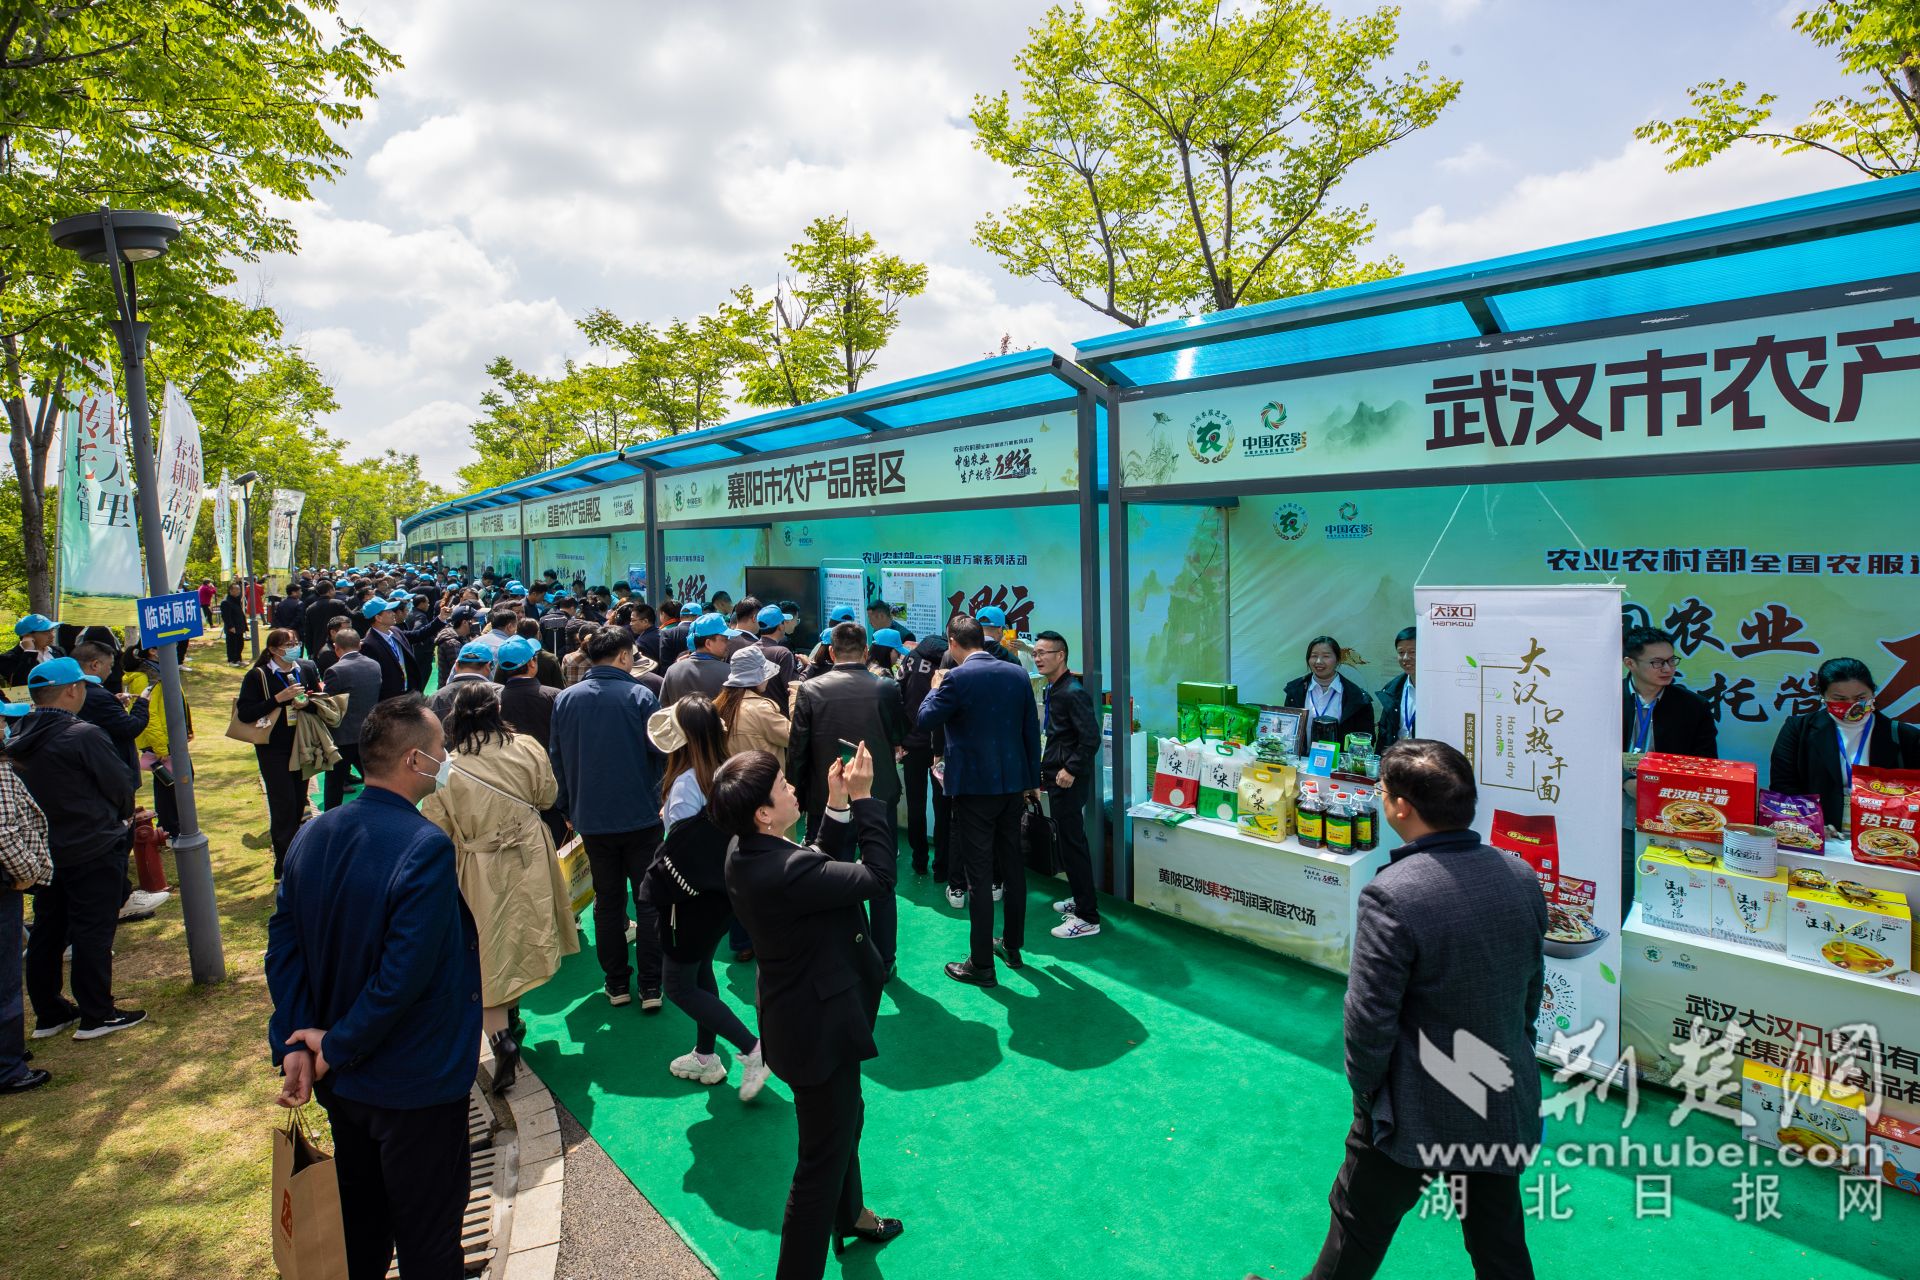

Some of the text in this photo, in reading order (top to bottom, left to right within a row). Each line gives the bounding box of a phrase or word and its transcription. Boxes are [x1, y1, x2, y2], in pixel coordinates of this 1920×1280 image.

[1243, 431, 1307, 451] 中国农影
[161, 435, 187, 541] 春耕春种
[176, 443, 199, 544] 农服先行
[728, 449, 906, 510] 襄阳市农产品展区
[547, 496, 601, 528] 宜昌市农产品展区
[144, 598, 197, 630] 临时厕所
[1434, 606, 1473, 617] 大汉口
[1506, 716, 1516, 779] Hot and dry
[1658, 787, 1731, 806] 武汉热干面
[1860, 812, 1916, 829] 热干面
